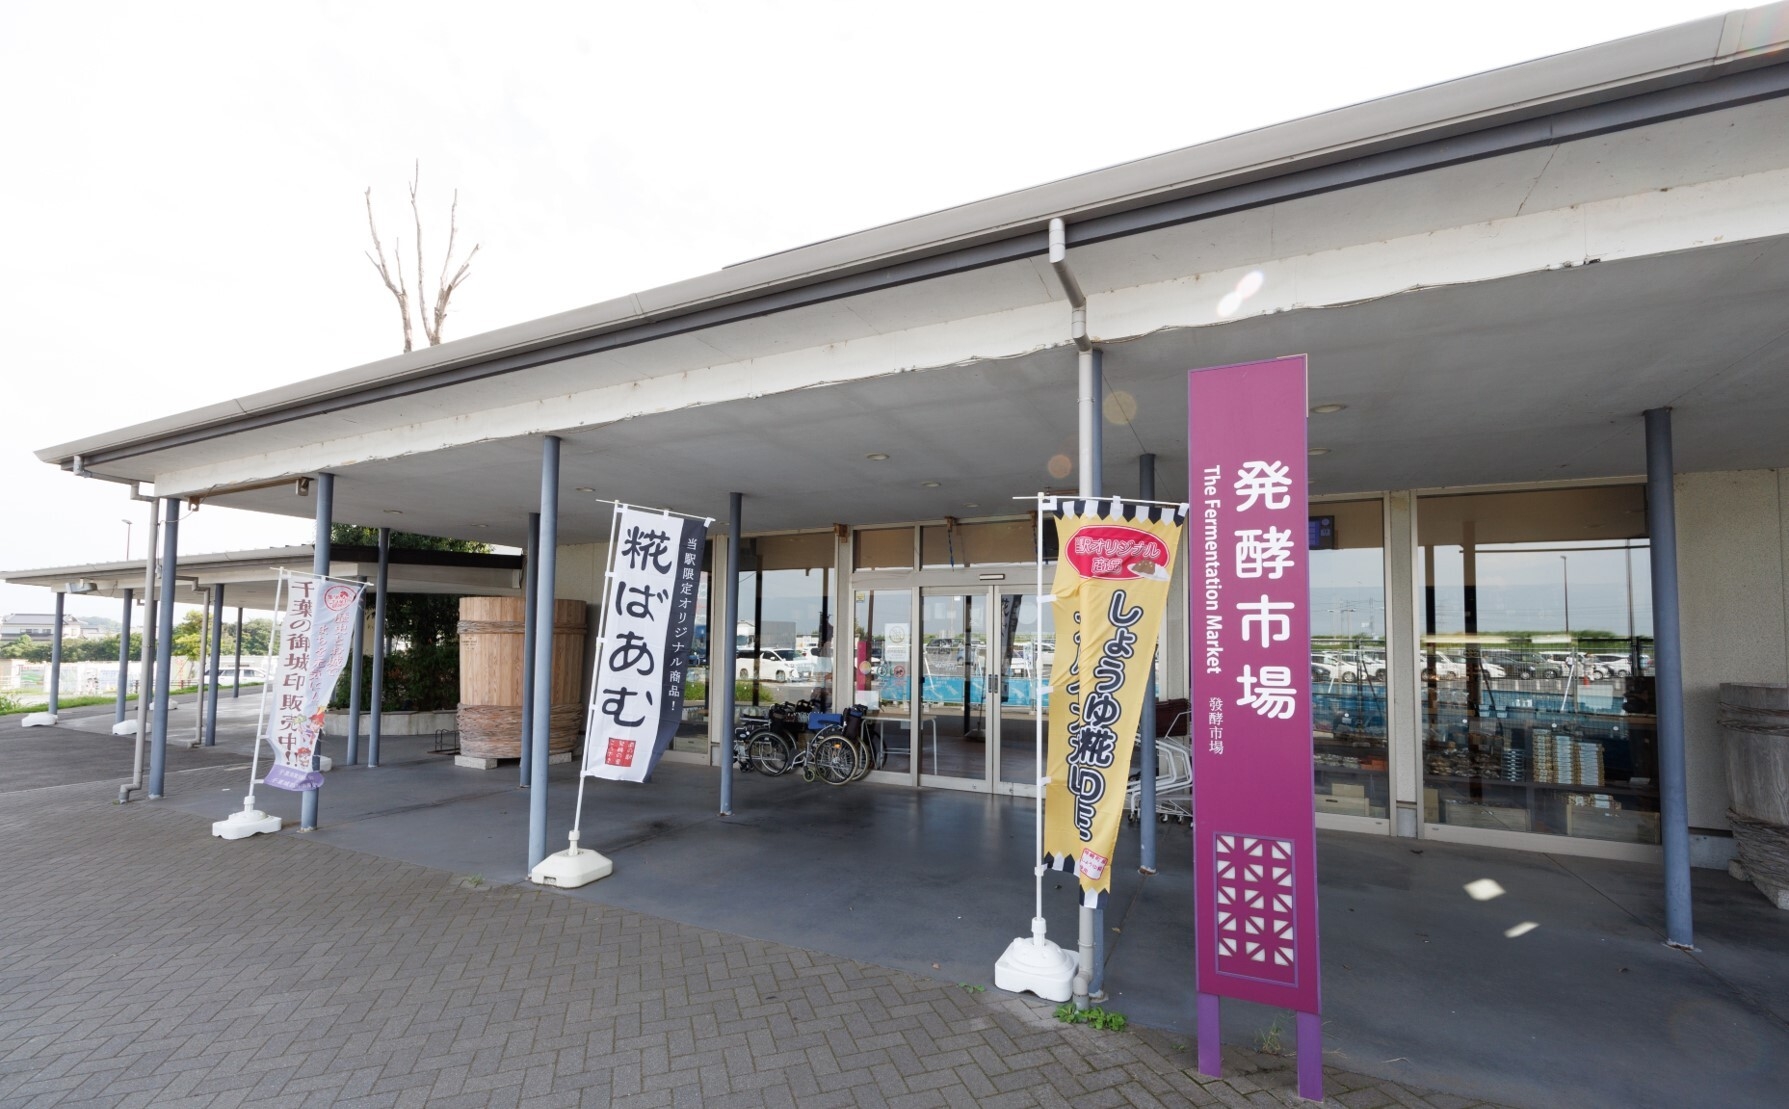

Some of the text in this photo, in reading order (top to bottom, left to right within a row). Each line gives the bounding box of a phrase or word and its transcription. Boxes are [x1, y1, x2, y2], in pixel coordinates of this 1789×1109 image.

[1074, 535, 1161, 559] 駅オリジナル
[1091, 556, 1123, 575] 商品
[1203, 464, 1222, 675] The Fermentation Market
[1234, 460, 1297, 720] 発酵市場
[601, 525, 674, 728] 糀ばあむ
[1208, 696, 1225, 756] 發酵市場
